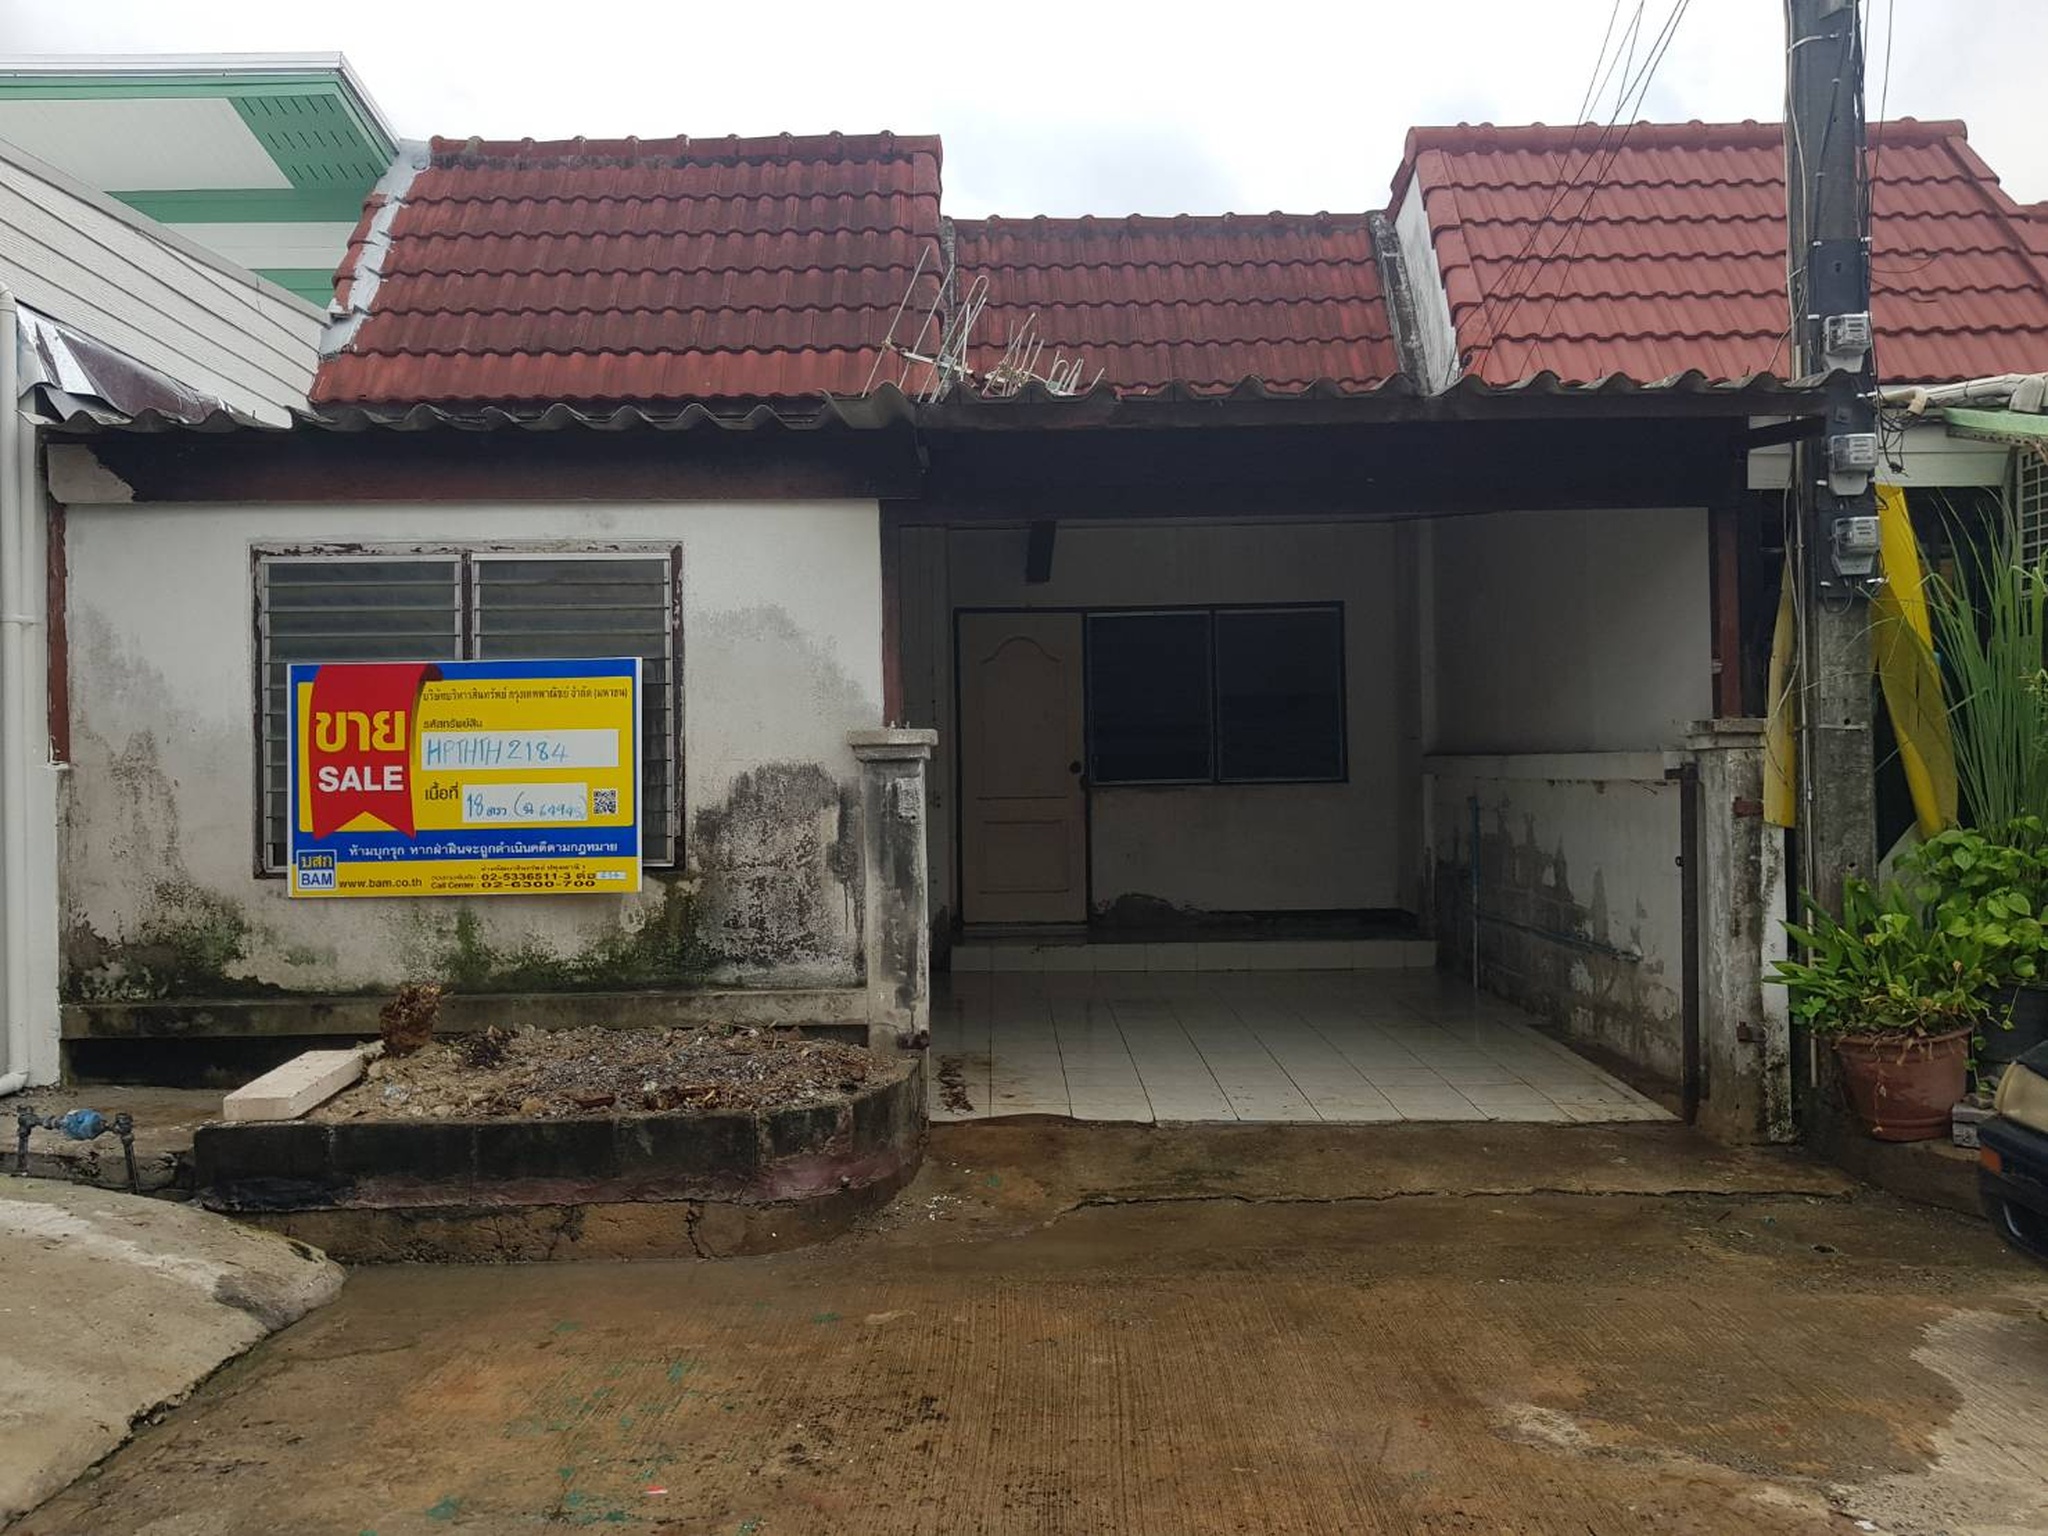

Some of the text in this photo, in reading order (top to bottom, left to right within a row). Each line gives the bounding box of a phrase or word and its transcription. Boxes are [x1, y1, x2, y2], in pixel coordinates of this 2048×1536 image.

[315, 710, 406, 752] ขาย
[318, 765, 404, 793] SALE
[425, 782, 459, 800] เนื้อที่
[349, 843, 405, 860] ห้ามบุกรุก
[302, 855, 333, 868] บสก
[302, 873, 332, 886] BAM
[339, 878, 422, 888] www.bam.co.th
